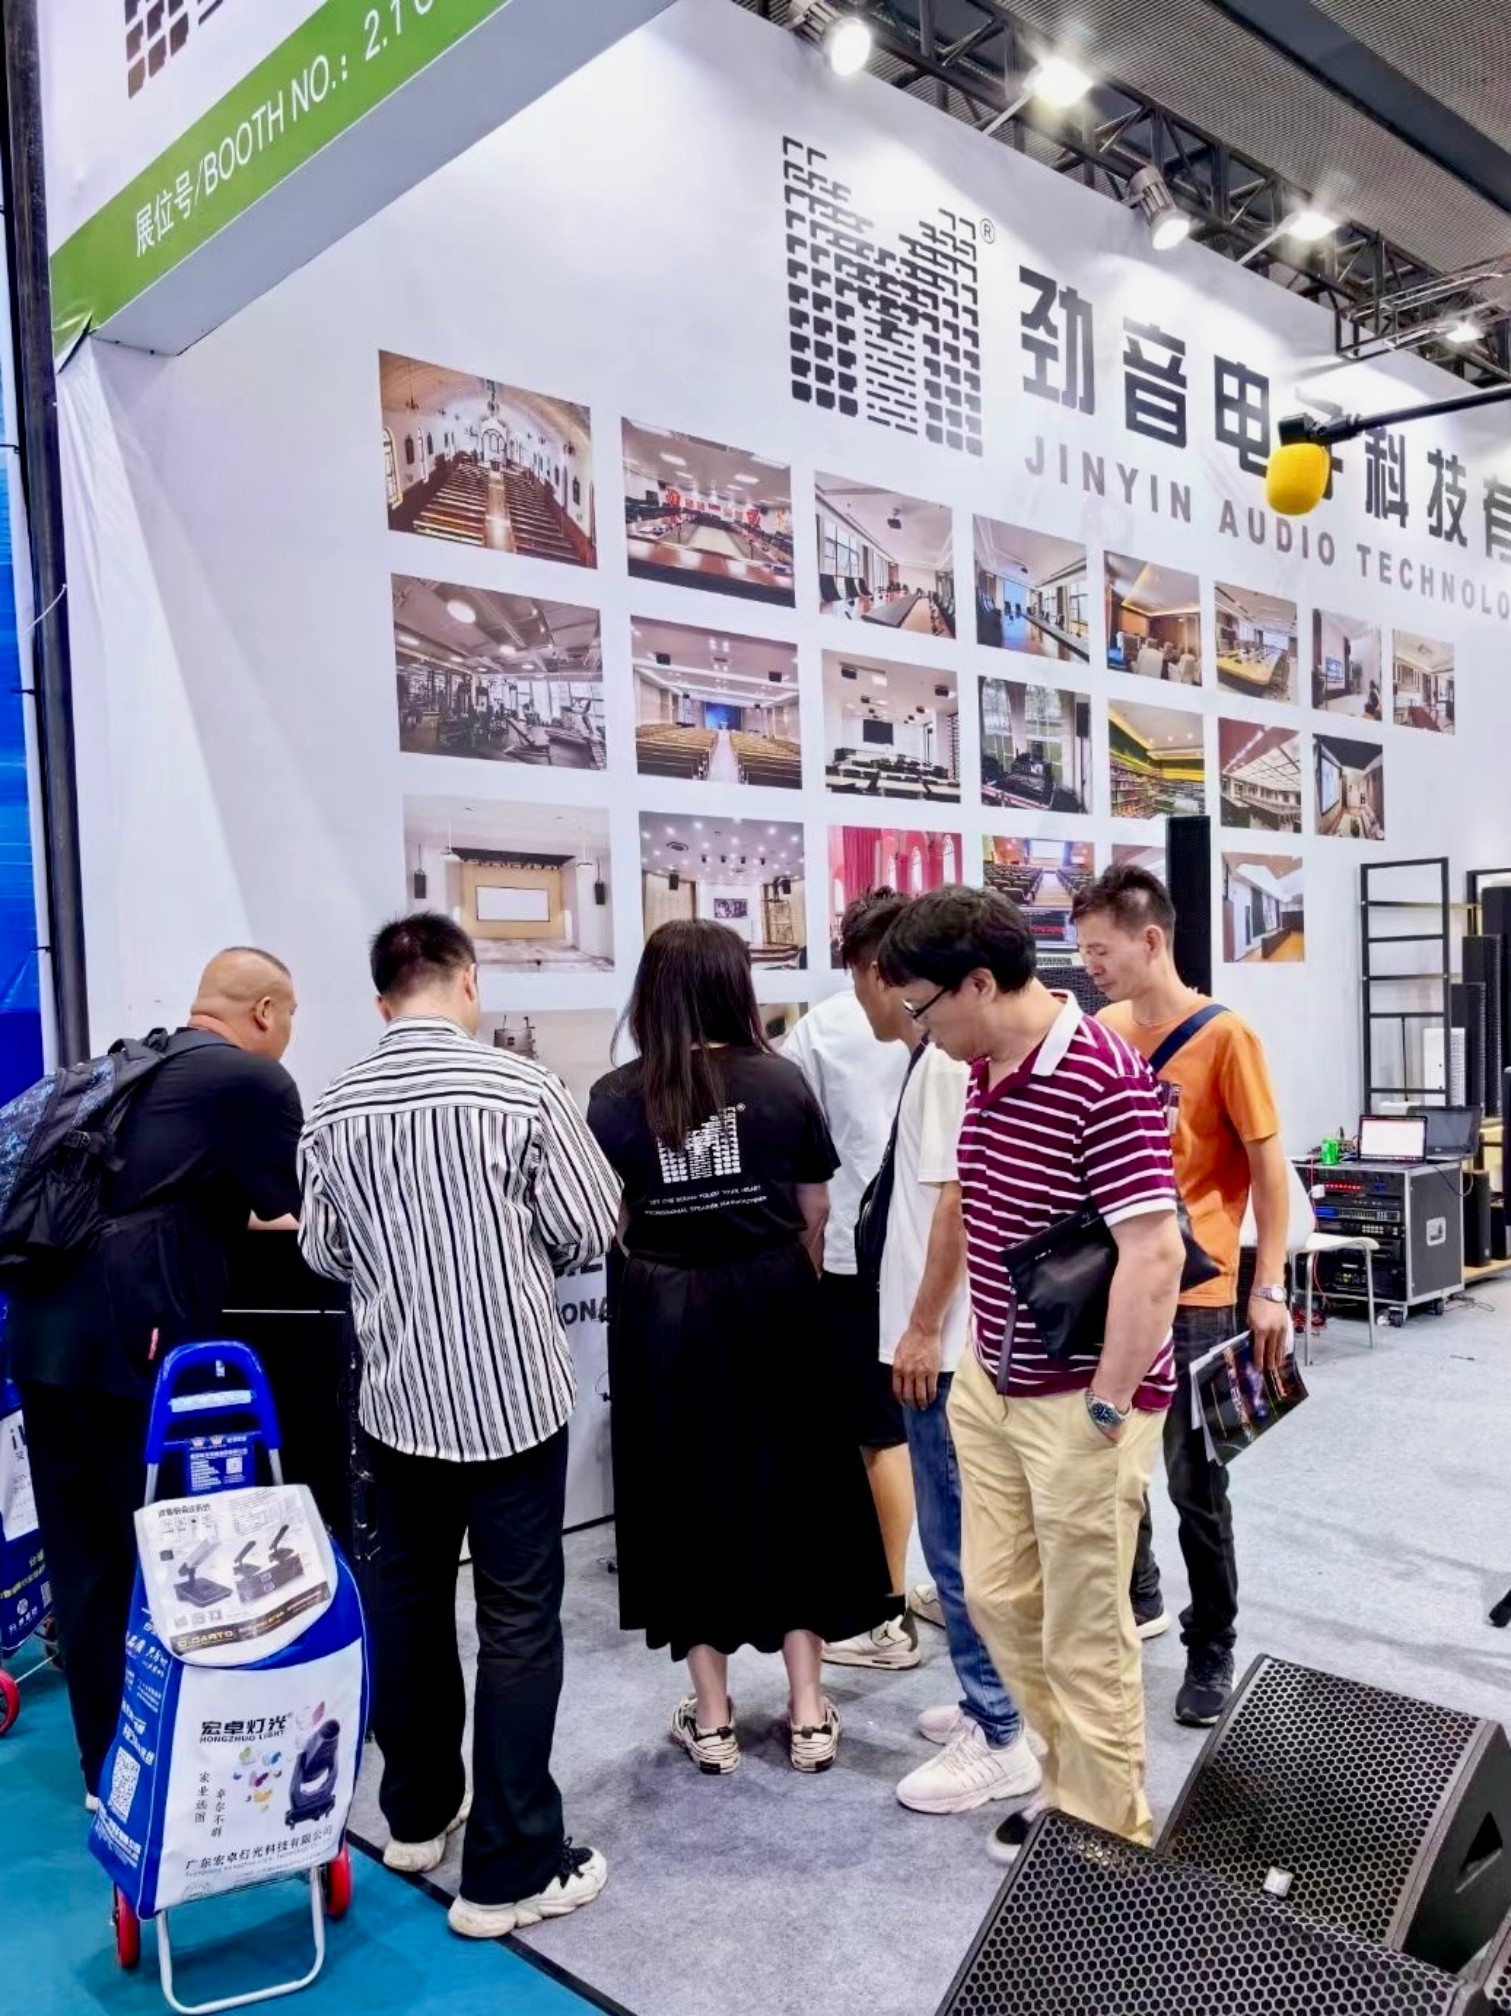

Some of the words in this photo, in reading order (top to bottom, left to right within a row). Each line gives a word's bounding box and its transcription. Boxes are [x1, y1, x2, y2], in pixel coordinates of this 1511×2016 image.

[136, 90, 284, 257] 展位号/BOOTH
[364, 0, 435, 61] 2.1
[1025, 436, 1191, 524] JINYIN
[1219, 500, 1336, 567] AUDIO
[200, 1735, 256, 1743] HONGZHUO
[259, 1730, 284, 1740] LIGHT
[201, 1715, 287, 1736] 宏卓灯光
[184, 1825, 333, 1870] 广东宏卓灯光科技有限公司
